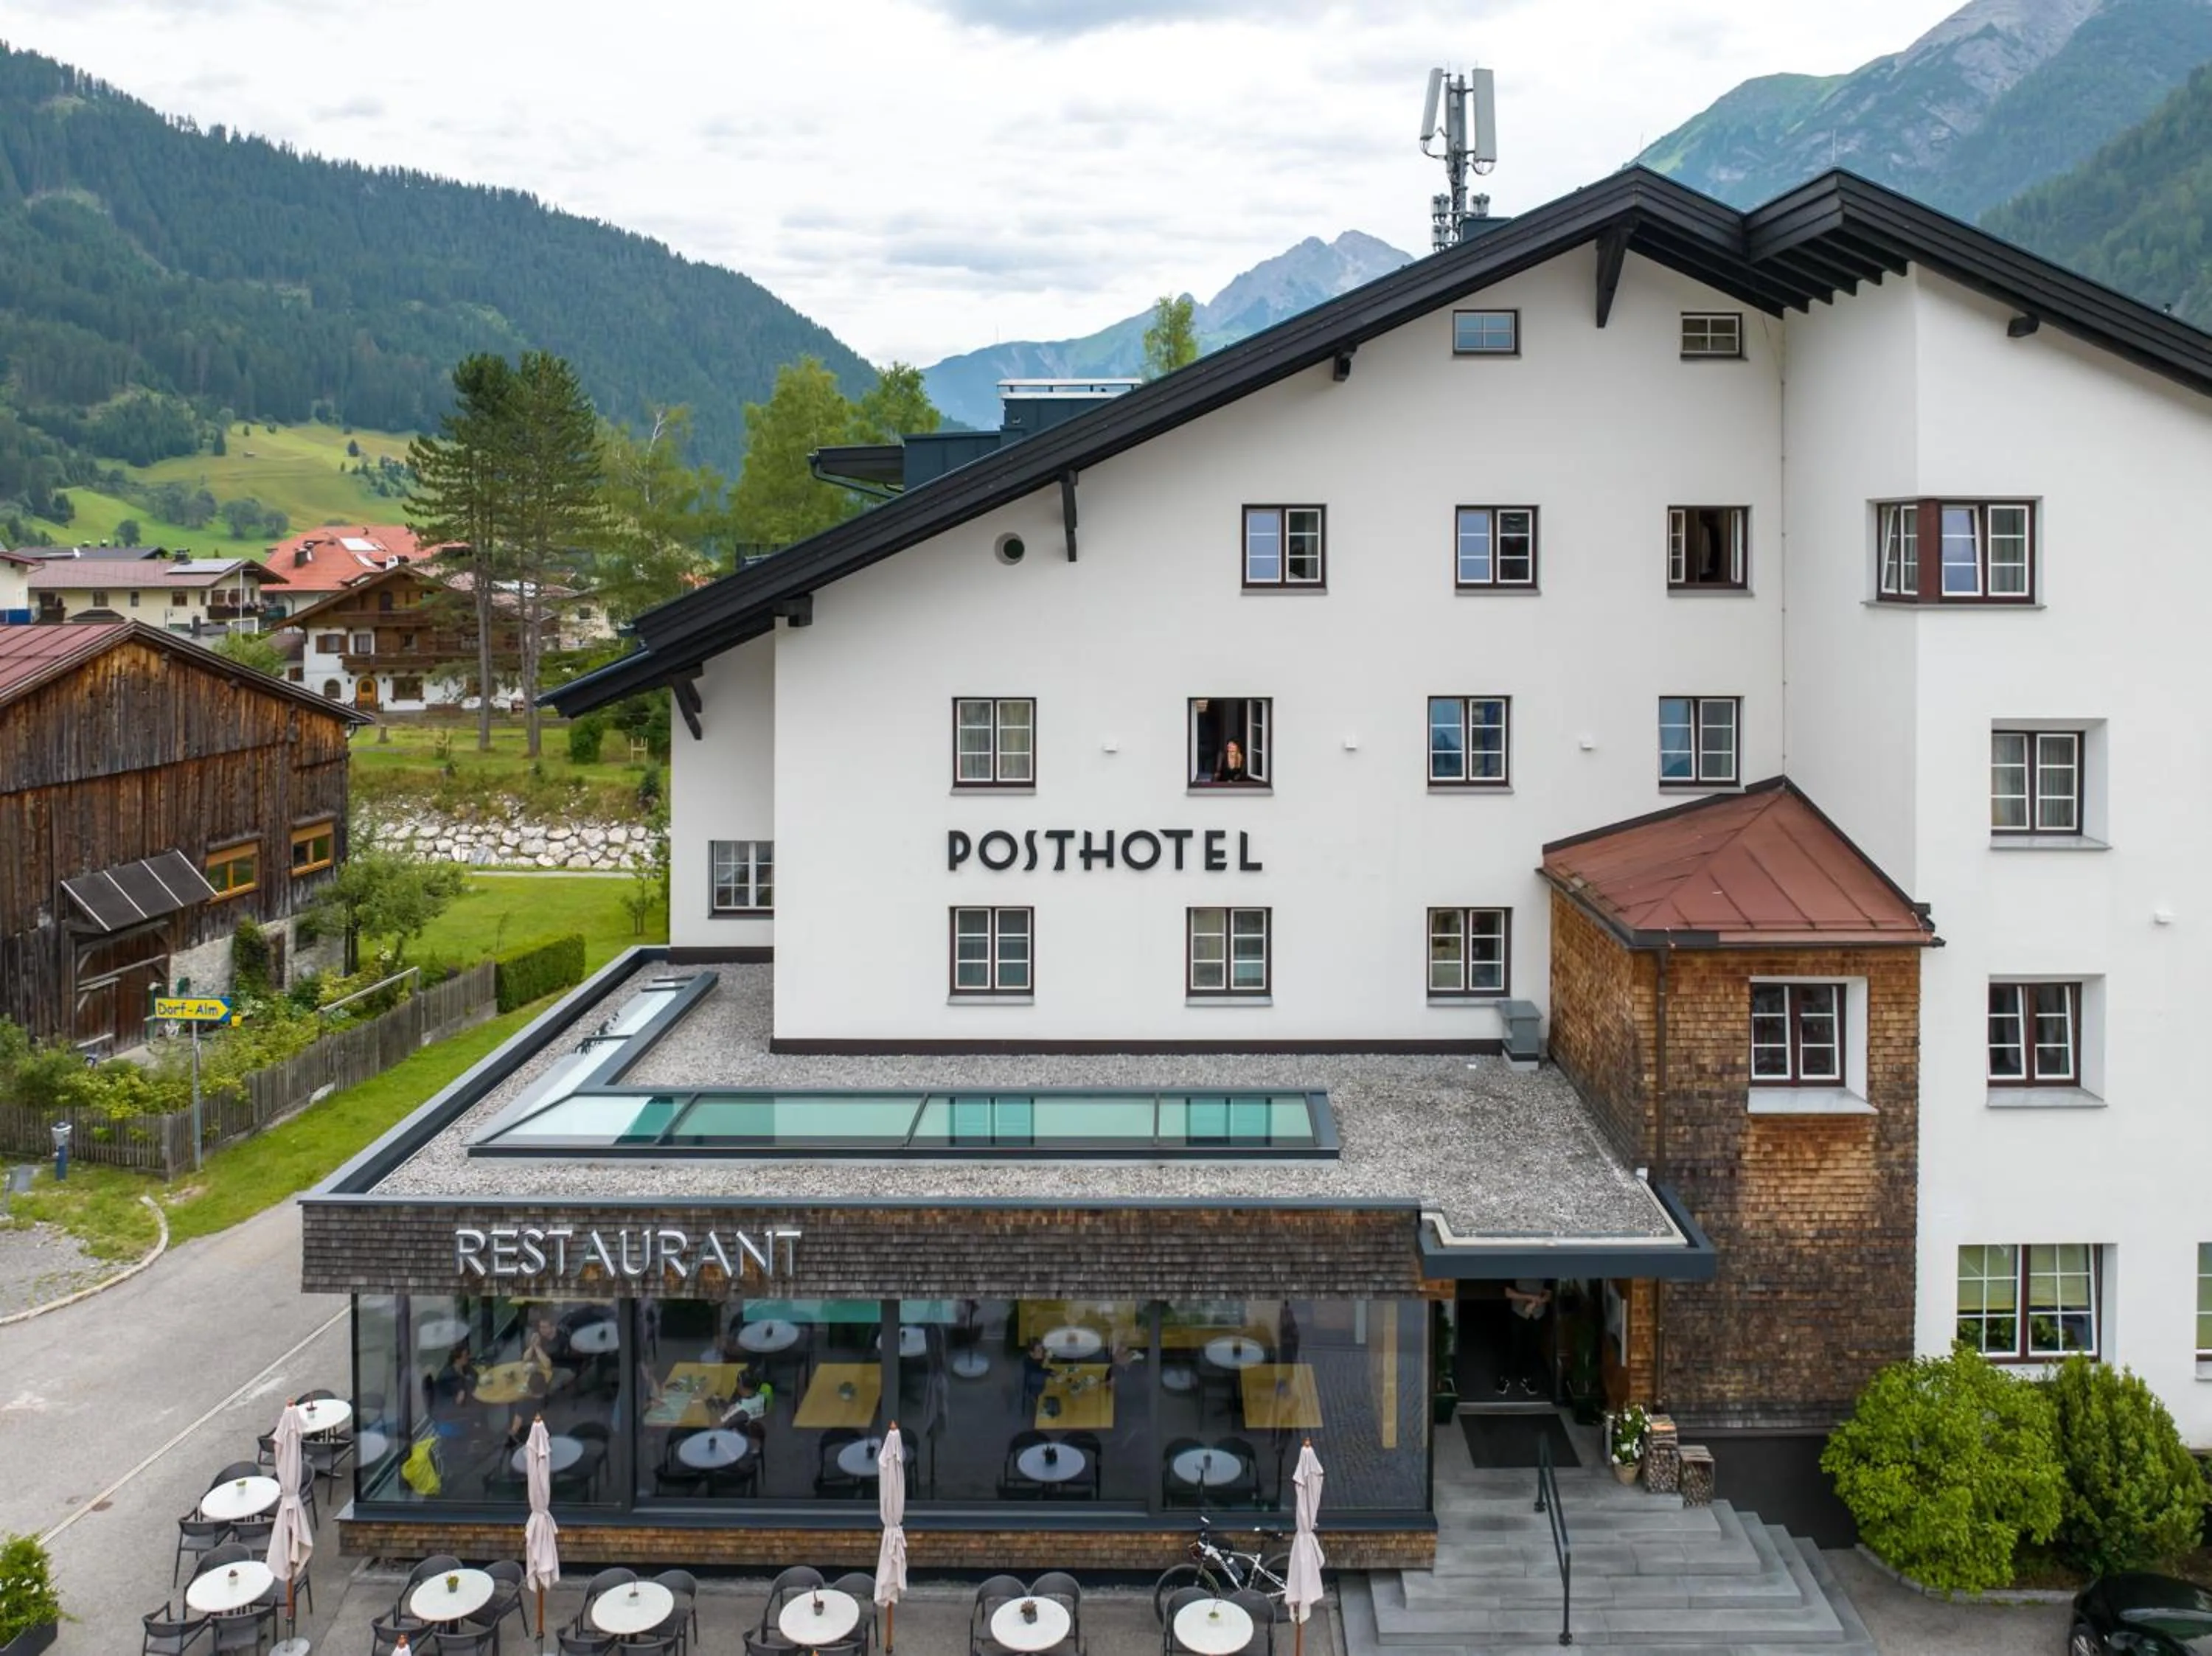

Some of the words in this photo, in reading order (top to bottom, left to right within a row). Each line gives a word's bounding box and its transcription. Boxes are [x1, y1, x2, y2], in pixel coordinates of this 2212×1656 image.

[947, 829, 1263, 872] POSTHOTEL
[158, 1002, 219, 1015] Dorf-Alm
[454, 1228, 802, 1278] RESTAURANT
